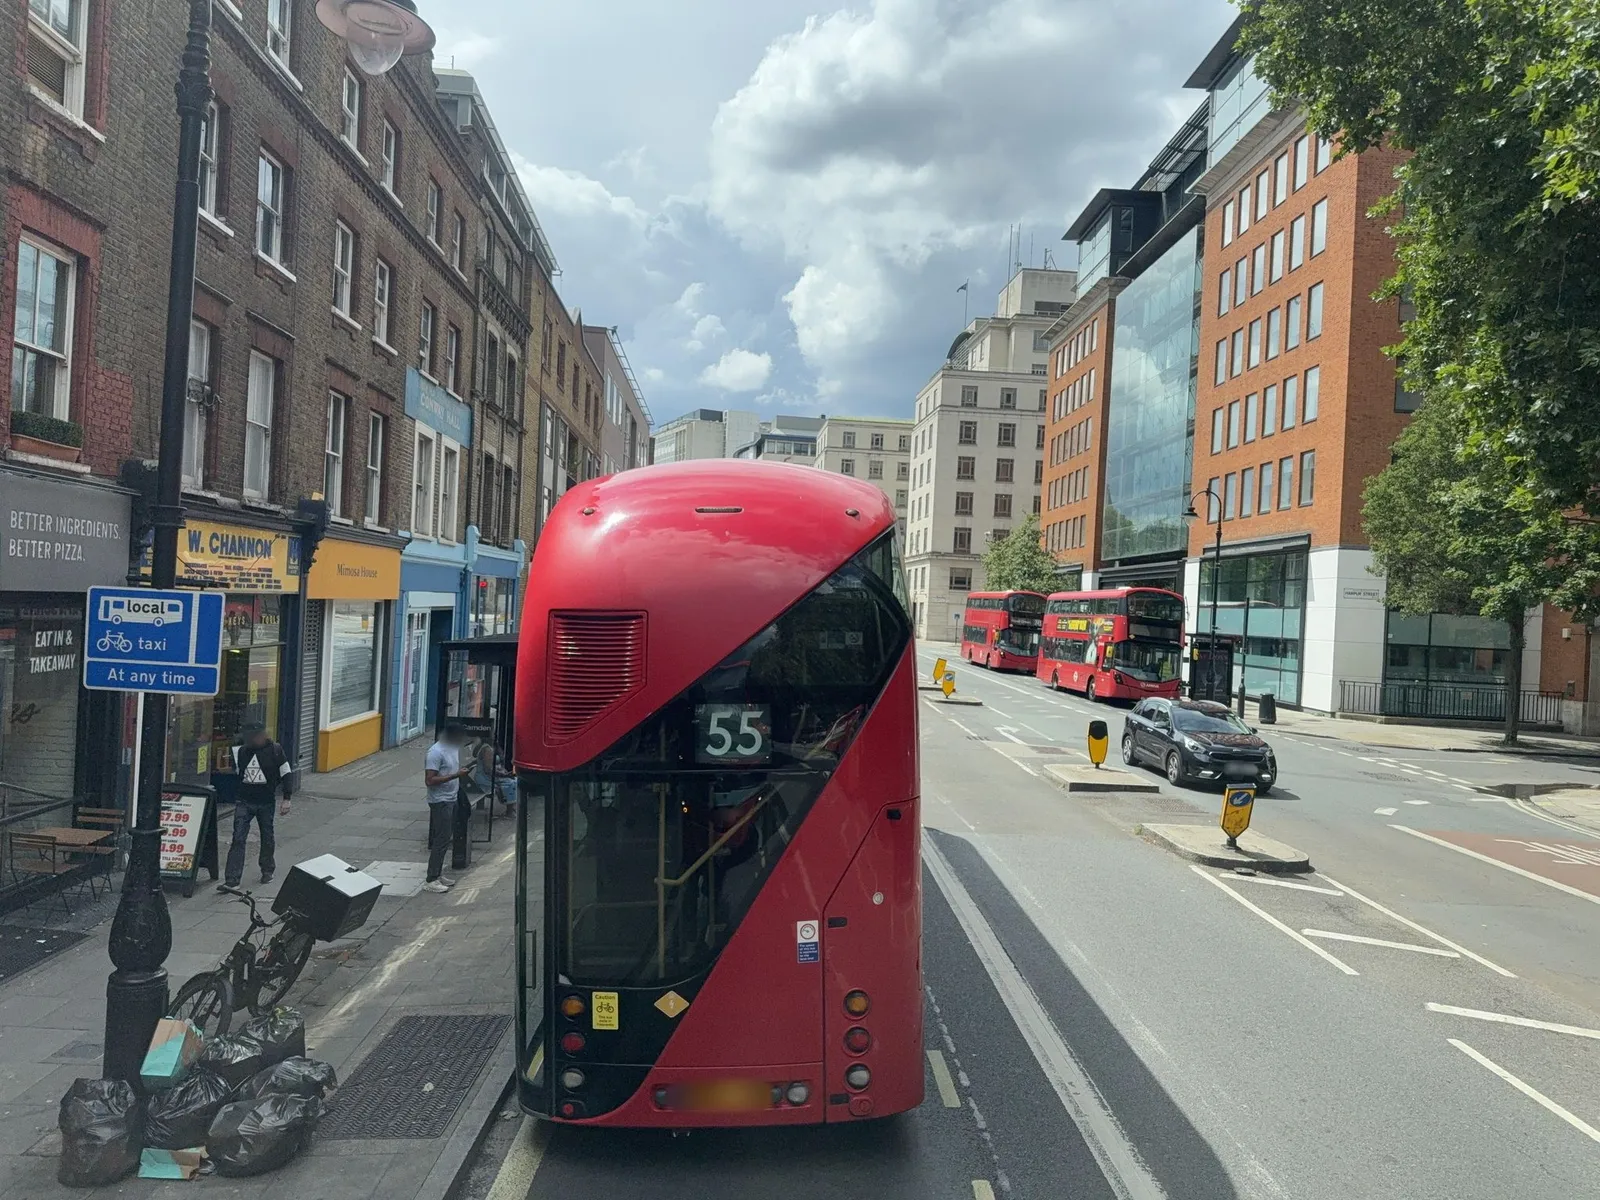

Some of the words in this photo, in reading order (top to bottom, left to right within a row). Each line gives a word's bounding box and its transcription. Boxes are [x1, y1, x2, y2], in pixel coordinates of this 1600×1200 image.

[10, 510, 53, 532] BETTER
[55, 516, 121, 540] INGREDIENTS.
[9, 538, 52, 559] BETTER
[54, 542, 86, 561] PIZZA.
[187, 529, 204, 553] W.
[209, 532, 272, 558] CHANNON
[336, 563, 360, 577] Mimosa
[360, 566, 378, 578] House
[127, 599, 165, 614] local
[228, 616, 246, 626] KEYS
[35, 630, 53, 648] EAT
[53, 629, 64, 647] IN
[65, 629, 73, 646] &
[138, 637, 167, 651] taxi
[30, 653, 76, 674] TAKEAWAY
[107, 667, 125, 682] At
[130, 671, 157, 686] any
[162, 670, 196, 686] time
[705, 710, 764, 756] 55
